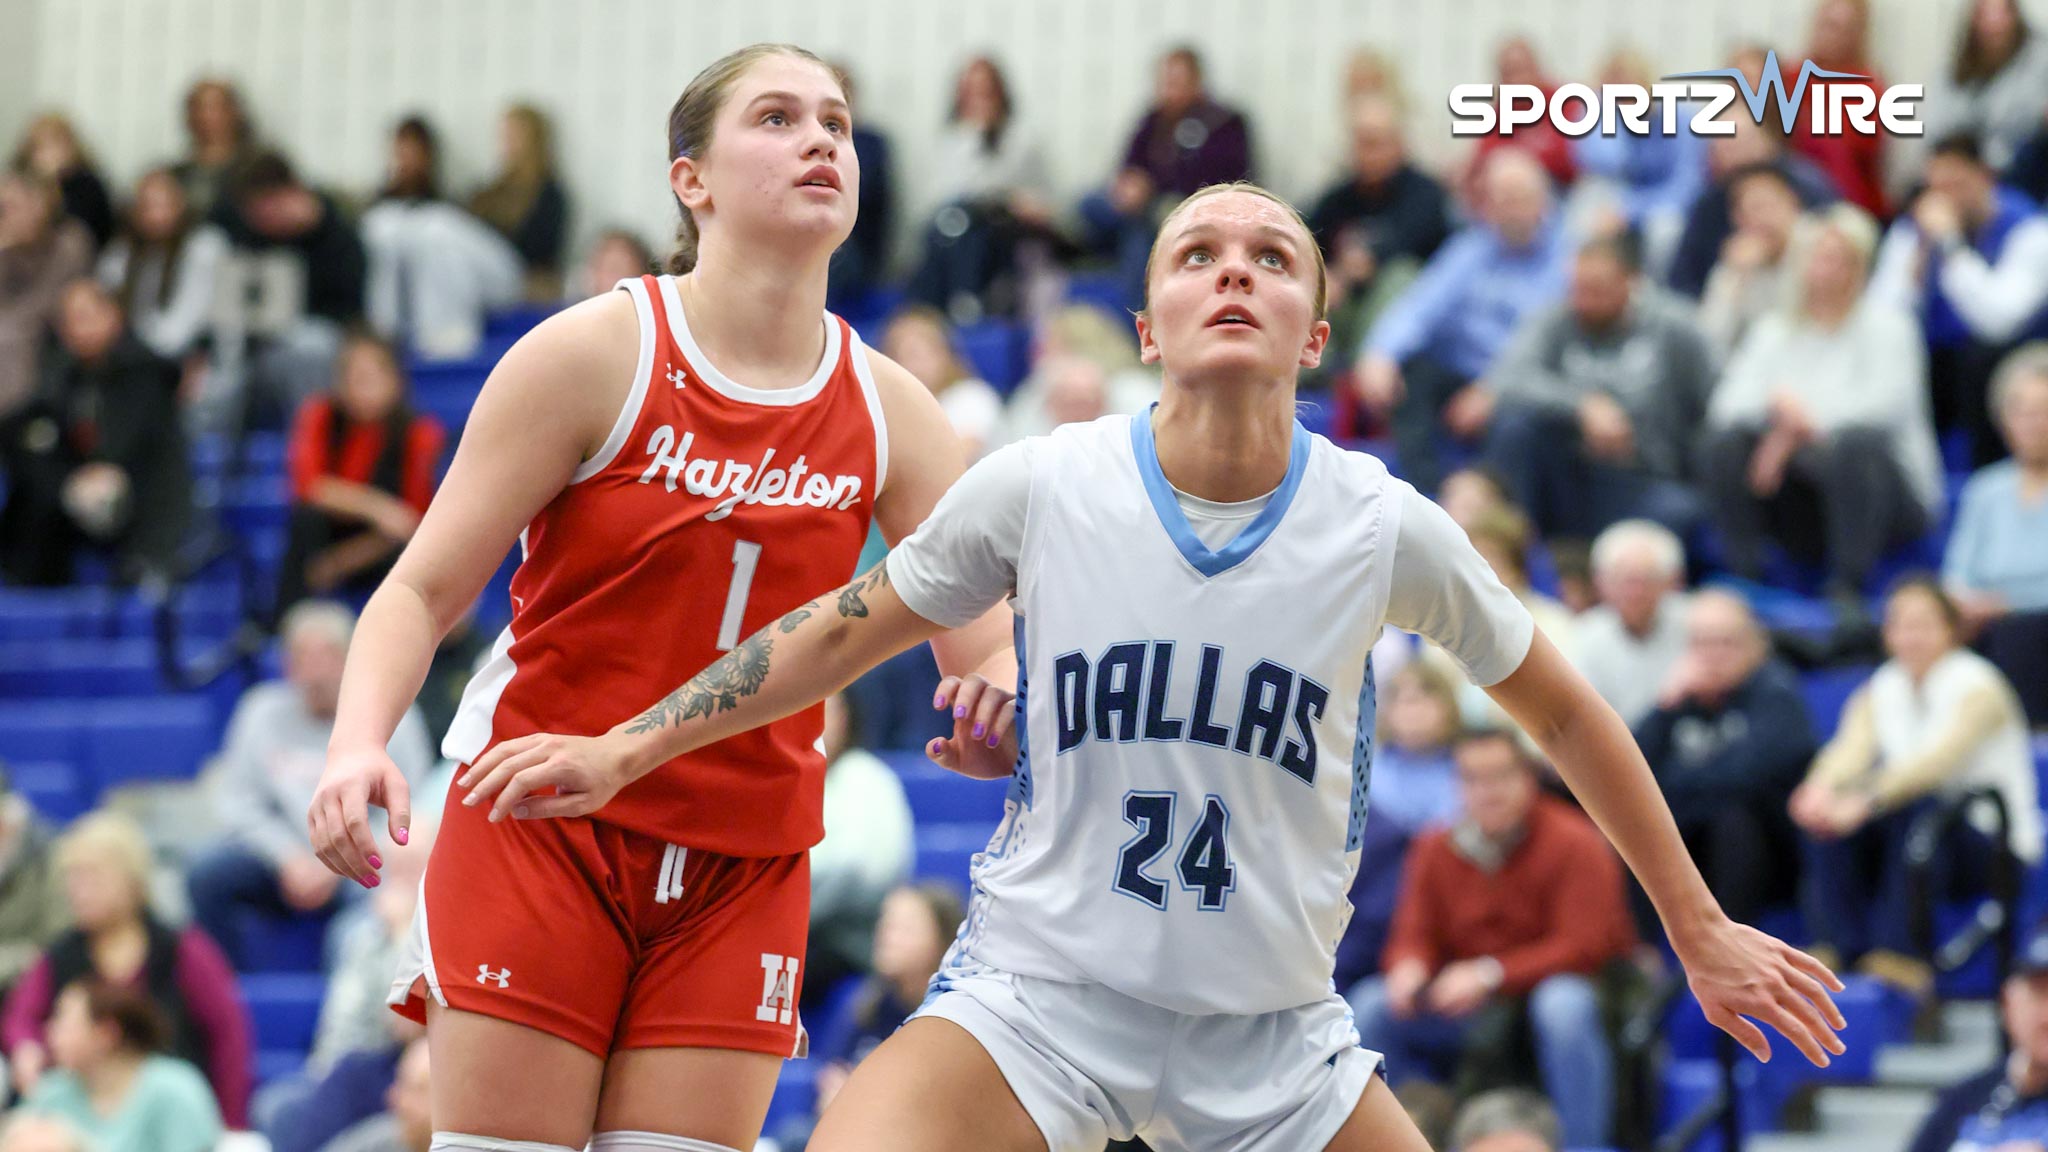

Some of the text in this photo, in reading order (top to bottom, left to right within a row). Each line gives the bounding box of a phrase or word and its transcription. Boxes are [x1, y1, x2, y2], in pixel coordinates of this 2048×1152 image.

[639, 425, 861, 521] Hazleton
[717, 540, 761, 651] 1
[1054, 640, 1330, 786] DALLAS
[1112, 791, 1236, 911] 24
